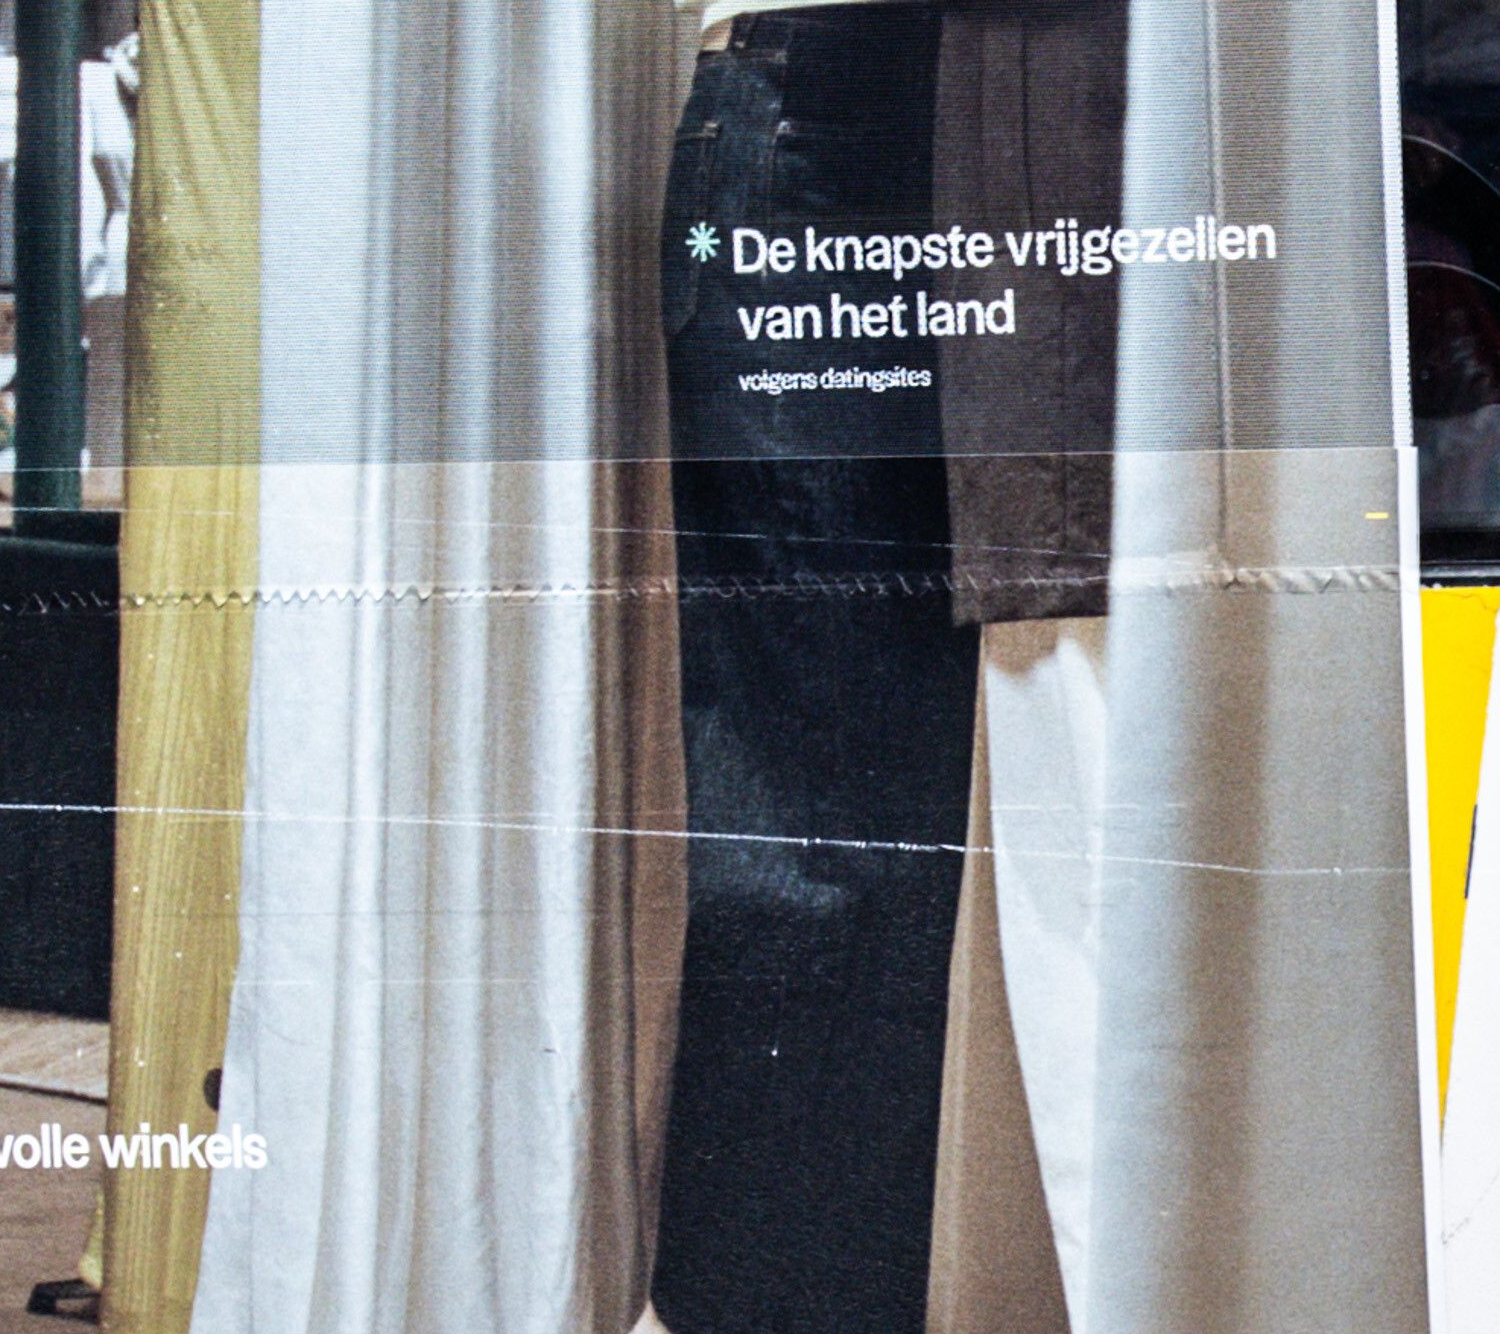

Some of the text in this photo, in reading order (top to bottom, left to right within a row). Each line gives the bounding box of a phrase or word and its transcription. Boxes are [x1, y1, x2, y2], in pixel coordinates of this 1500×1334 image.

[806, 223, 995, 281] knapste
[1005, 216, 1277, 277] vrijgezellen
[737, 288, 1016, 341] van het land
[738, 364, 931, 393] volgens datingsites
[100, 1122, 268, 1170] winkels
